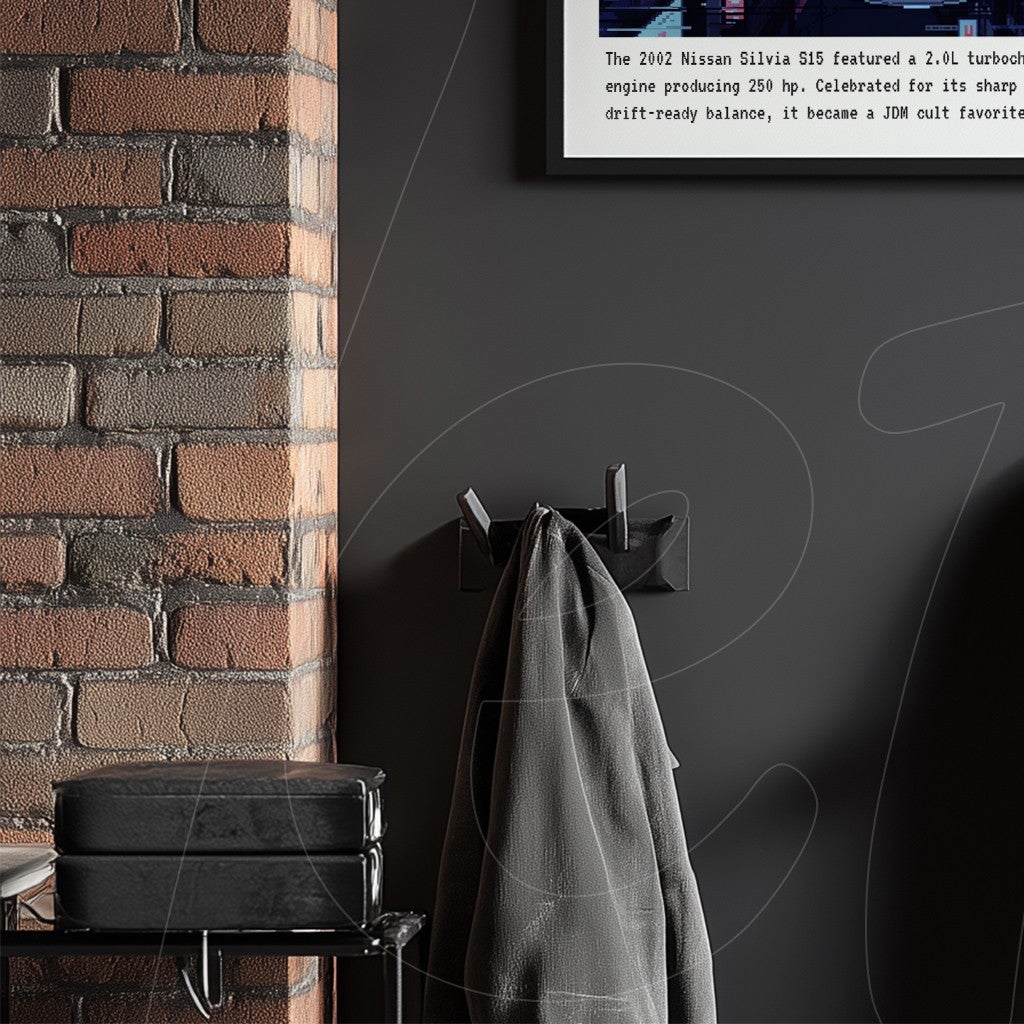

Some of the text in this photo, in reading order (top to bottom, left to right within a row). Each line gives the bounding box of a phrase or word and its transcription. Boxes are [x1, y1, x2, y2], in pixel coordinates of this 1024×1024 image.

[605, 51, 631, 66] The
[639, 51, 673, 66] 2002
[681, 51, 732, 66] Nissan
[740, 51, 791, 66] Silvia
[798, 50, 824, 66] S15
[833, 50, 900, 66] featured
[907, 54, 917, 66] a
[925, 50, 959, 66] 2.0L
[605, 78, 656, 97] engine
[664, 78, 740, 97] producing
[748, 78, 773, 93] 250
[782, 78, 806, 97] hp.
[815, 78, 900, 93] Celebrated
[908, 78, 934, 93] for
[942, 78, 967, 93] its
[976, 78, 1018, 96] sharp
[605, 106, 698, 124] drift-ready
[706, 106, 772, 124] balance,
[782, 105, 798, 120] it
[807, 106, 858, 120] became
[866, 109, 875, 120] a
[883, 105, 909, 120] JDM
[916, 105, 950, 120] cult
